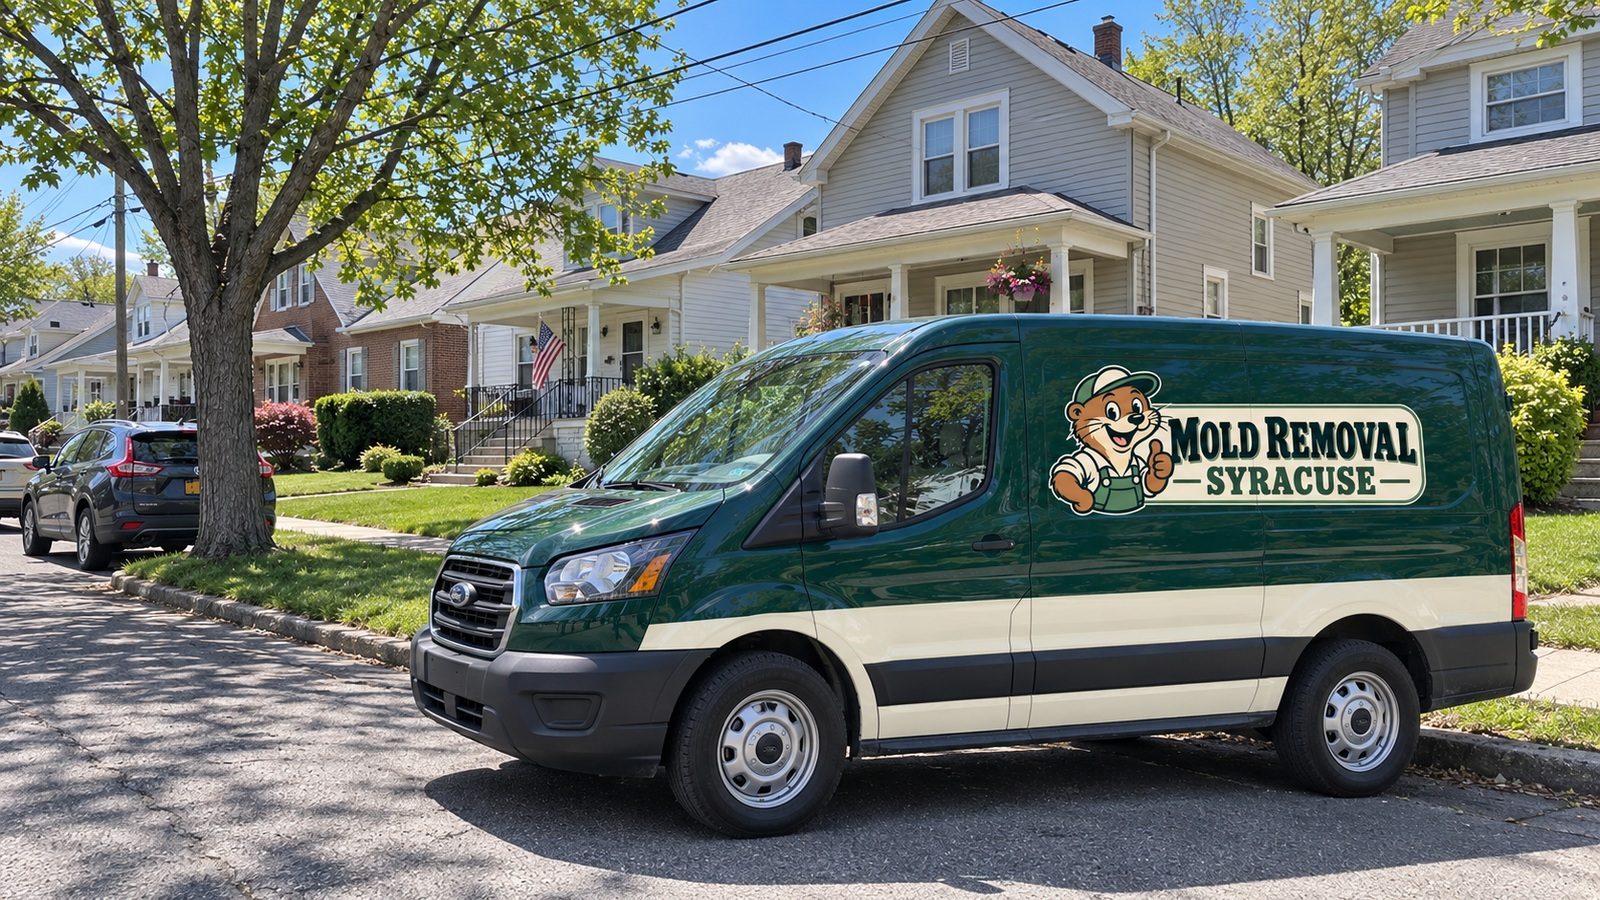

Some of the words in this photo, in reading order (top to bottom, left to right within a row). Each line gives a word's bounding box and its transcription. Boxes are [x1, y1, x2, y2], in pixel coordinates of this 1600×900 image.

[1168, 416, 1260, 464] MOLD
[1265, 416, 1416, 464] REMOVAL
[1206, 466, 1376, 495] SYRACUSE
